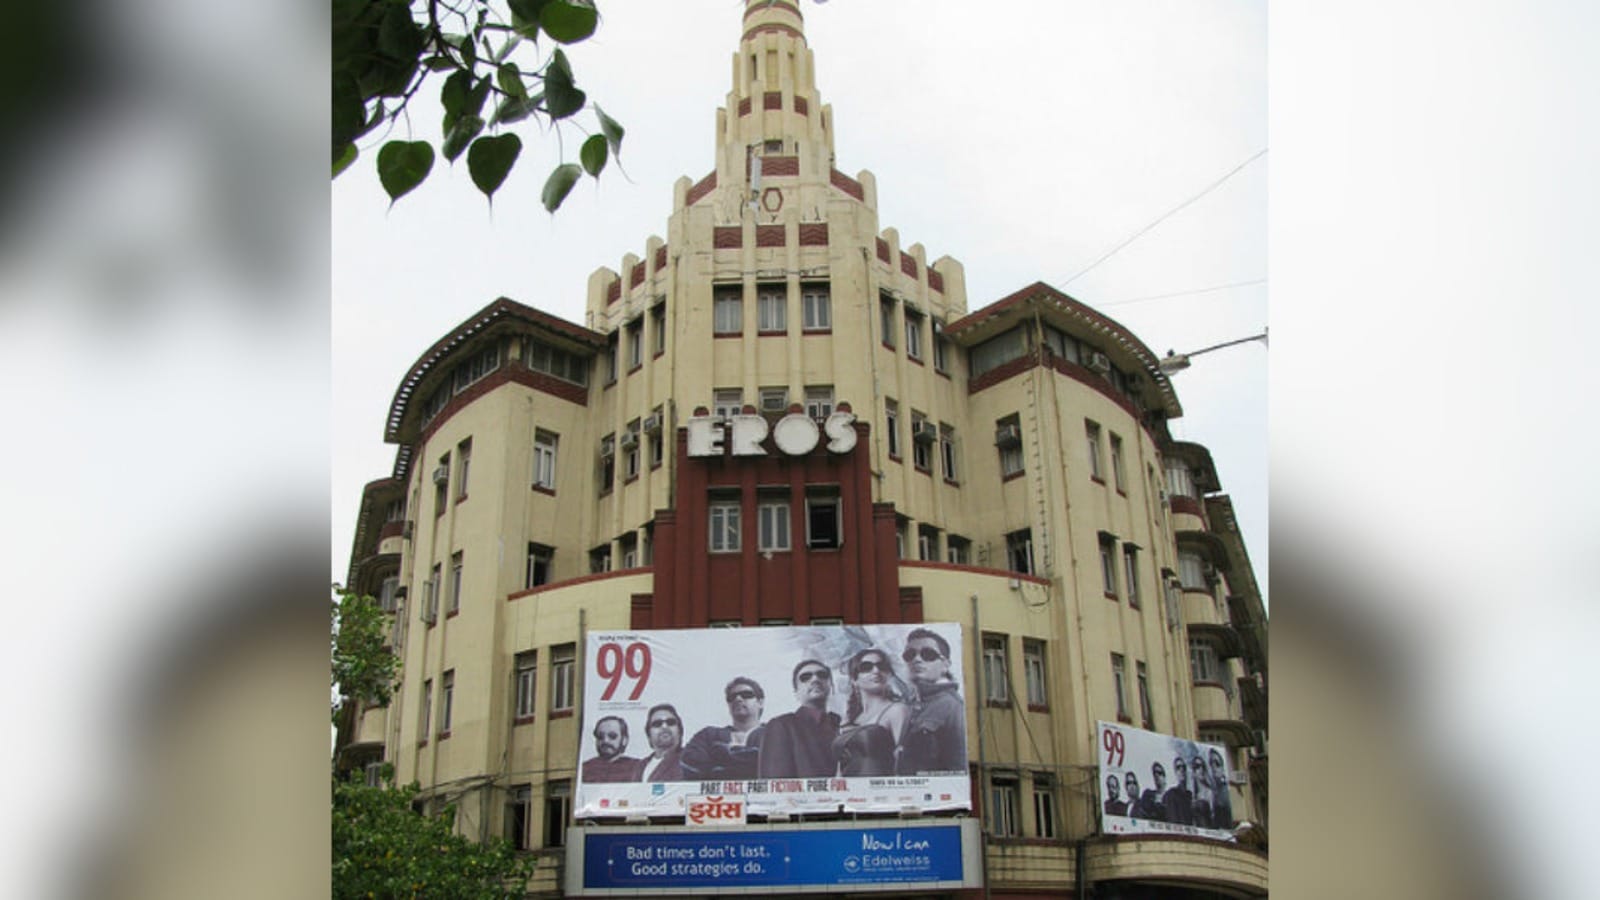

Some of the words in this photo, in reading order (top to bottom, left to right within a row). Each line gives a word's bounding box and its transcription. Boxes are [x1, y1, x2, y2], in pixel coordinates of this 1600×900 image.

[687, 411, 857, 456] EROS
[596, 642, 652, 701] 99
[1104, 729, 1125, 767] 99
[700, 782, 721, 795] PART
[689, 796, 743, 824] इरॉस
[862, 832, 893, 850] Now
[904, 840, 930, 850] can
[626, 847, 652, 859] Bad
[657, 847, 694, 858] times
[698, 846, 736, 858] don't
[740, 845, 771, 857] last.
[862, 855, 931, 867] Edelweiss
[631, 862, 667, 875] Good
[671, 863, 739, 877] strategies
[743, 861, 766, 874] do.
